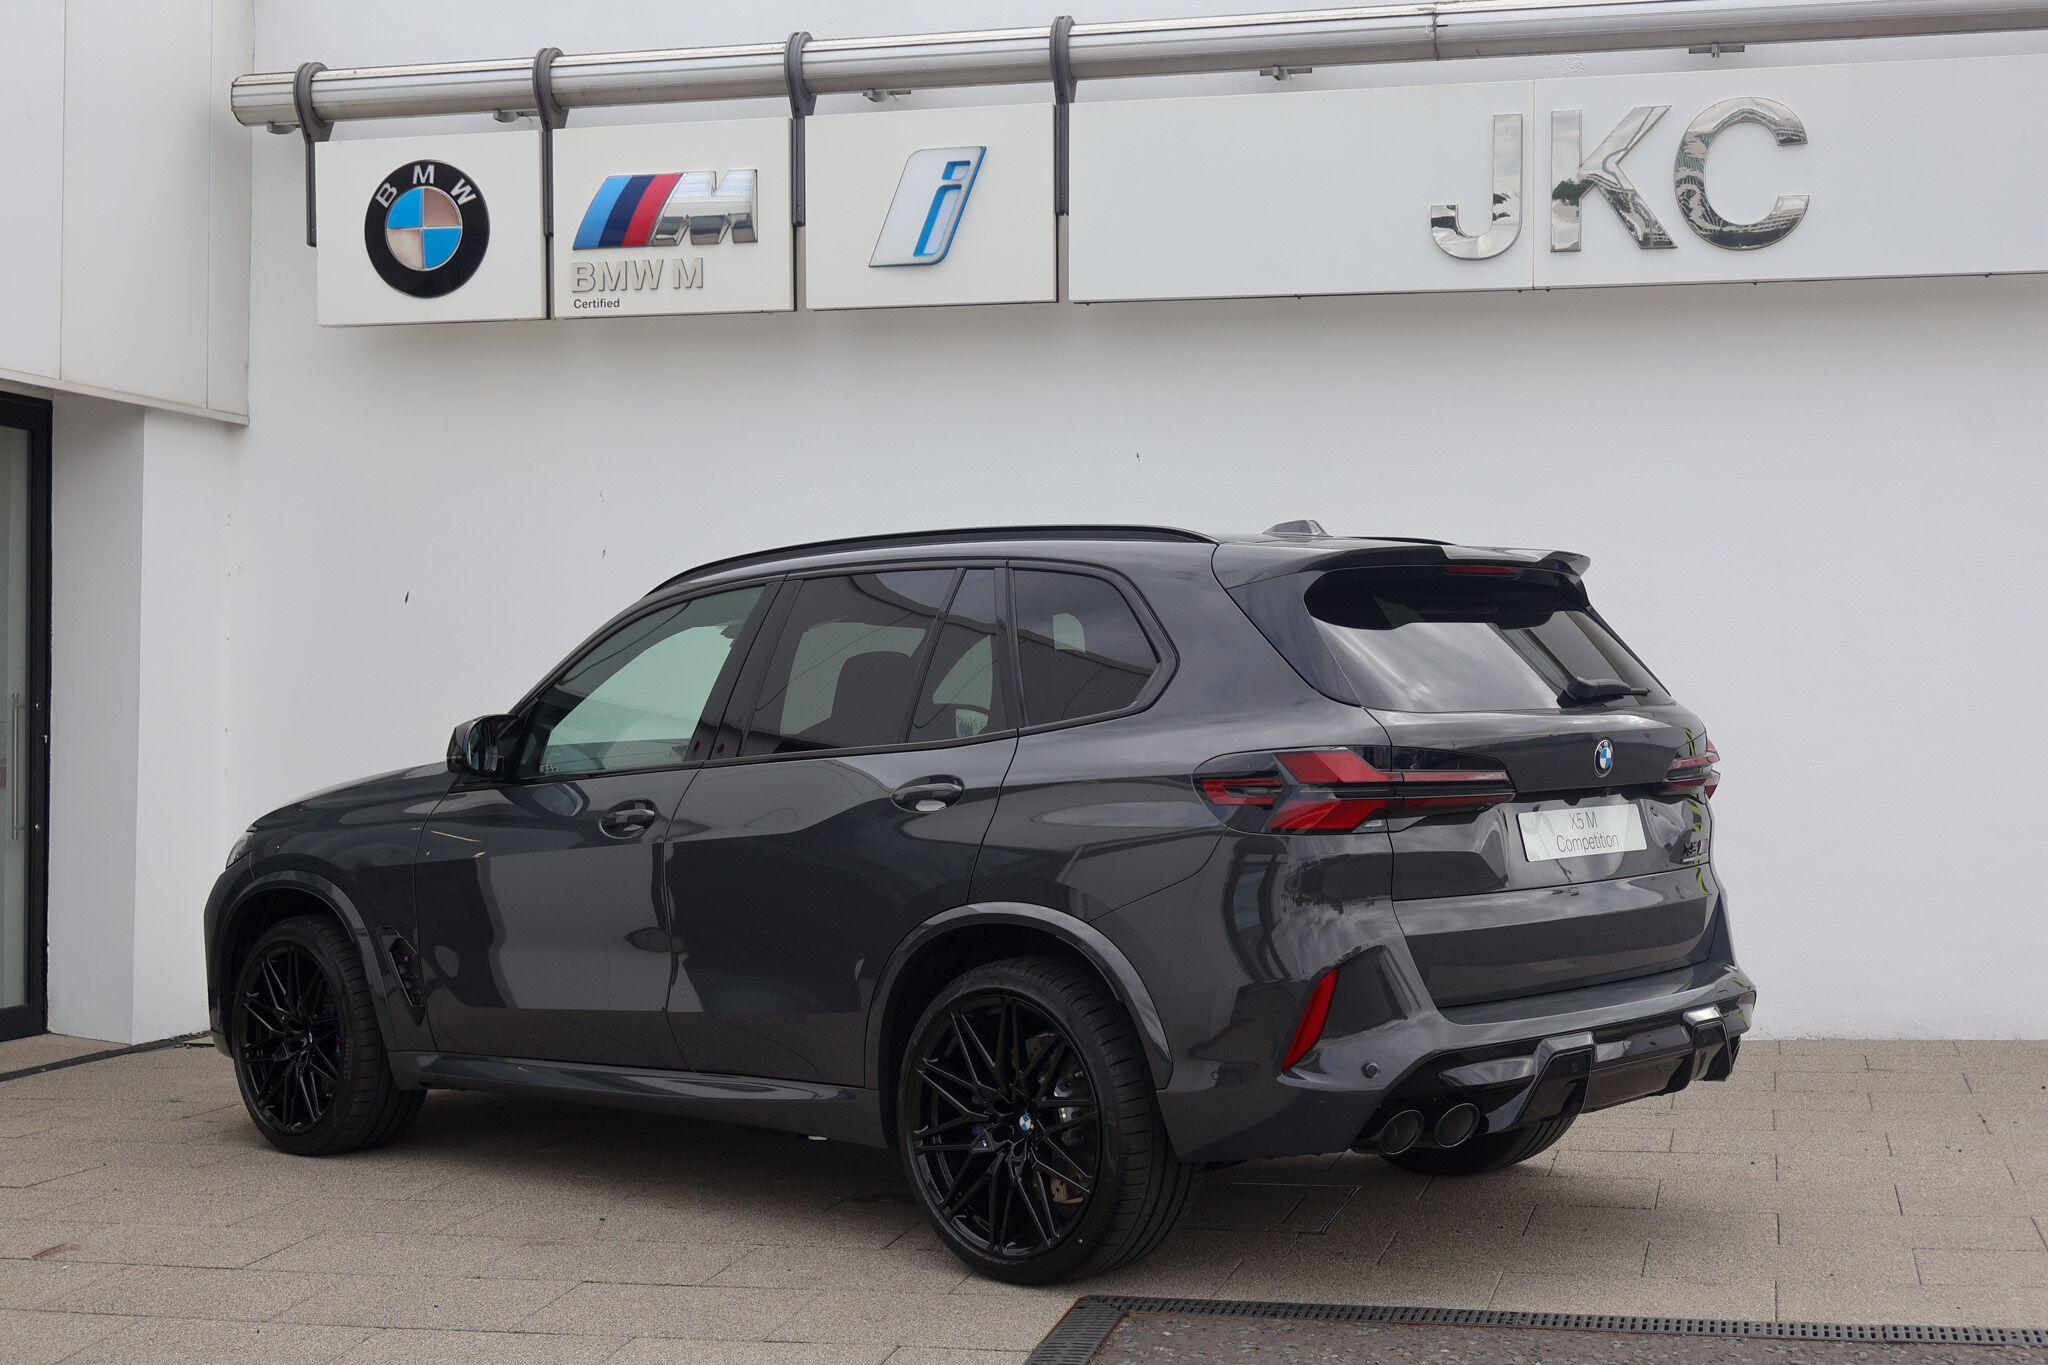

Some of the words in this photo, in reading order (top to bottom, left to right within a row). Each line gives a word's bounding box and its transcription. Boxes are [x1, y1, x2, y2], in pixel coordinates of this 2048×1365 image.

[375, 164, 477, 208] BMW
[1430, 96, 1811, 260] JKC
[571, 258, 664, 293] BMW
[672, 257, 704, 290] M
[573, 298, 621, 309] Certified
[1568, 812, 1585, 830] X5
[1585, 811, 1598, 829] M
[1556, 831, 1620, 853] Competition
